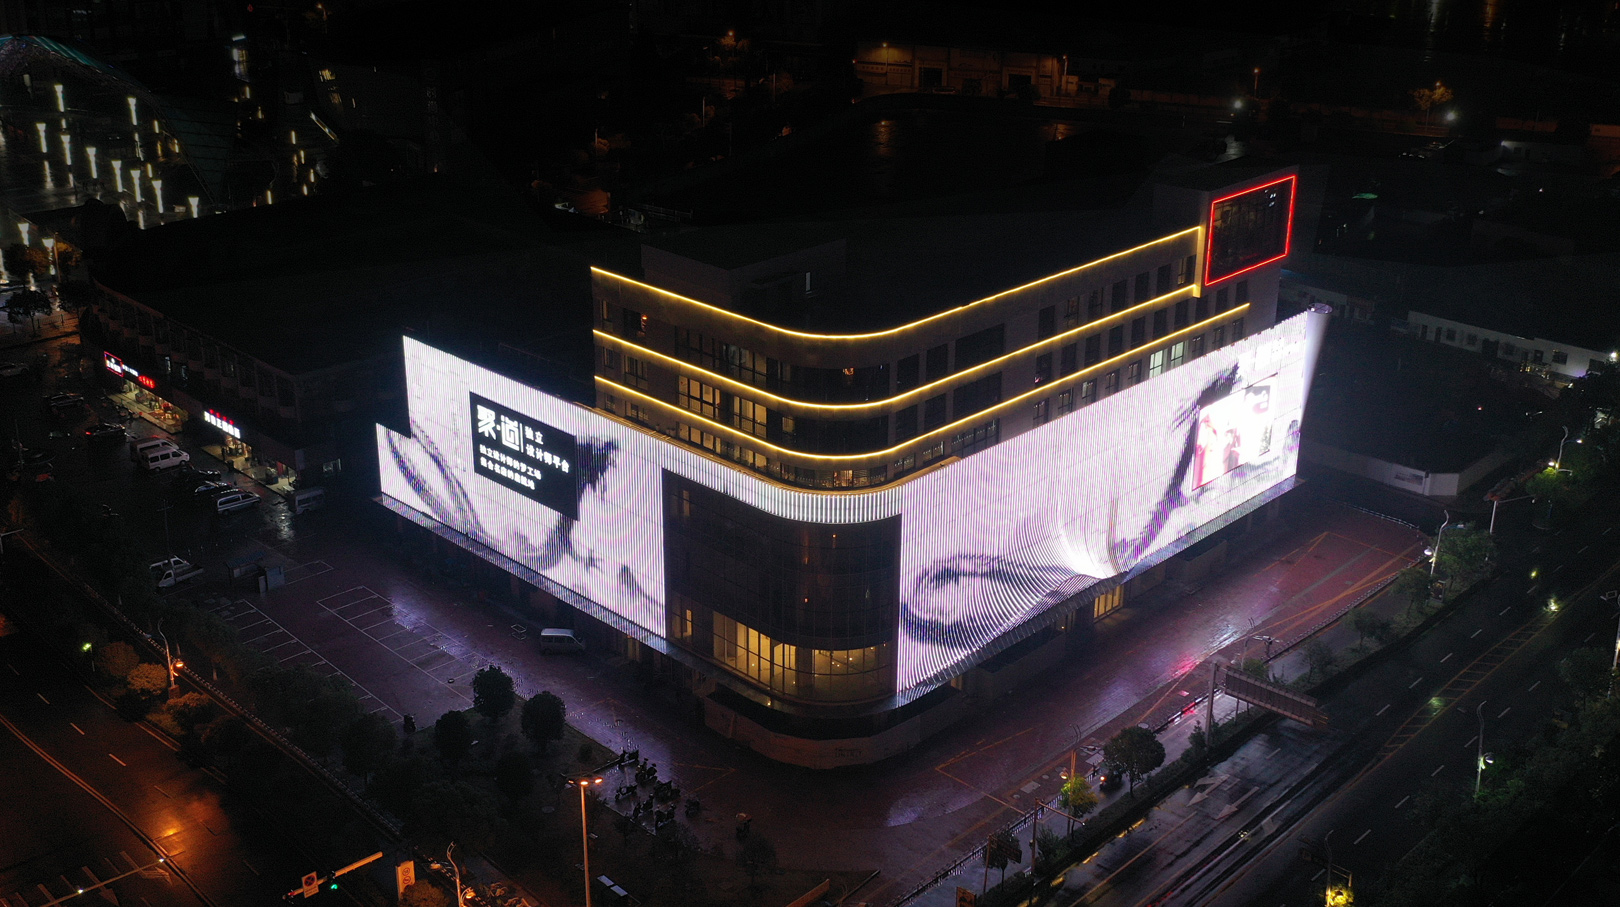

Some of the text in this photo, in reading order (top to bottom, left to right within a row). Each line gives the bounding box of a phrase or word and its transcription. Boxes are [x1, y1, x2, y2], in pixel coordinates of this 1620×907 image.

[524, 425, 544, 445] 独立
[525, 443, 570, 474] 设计师平台
